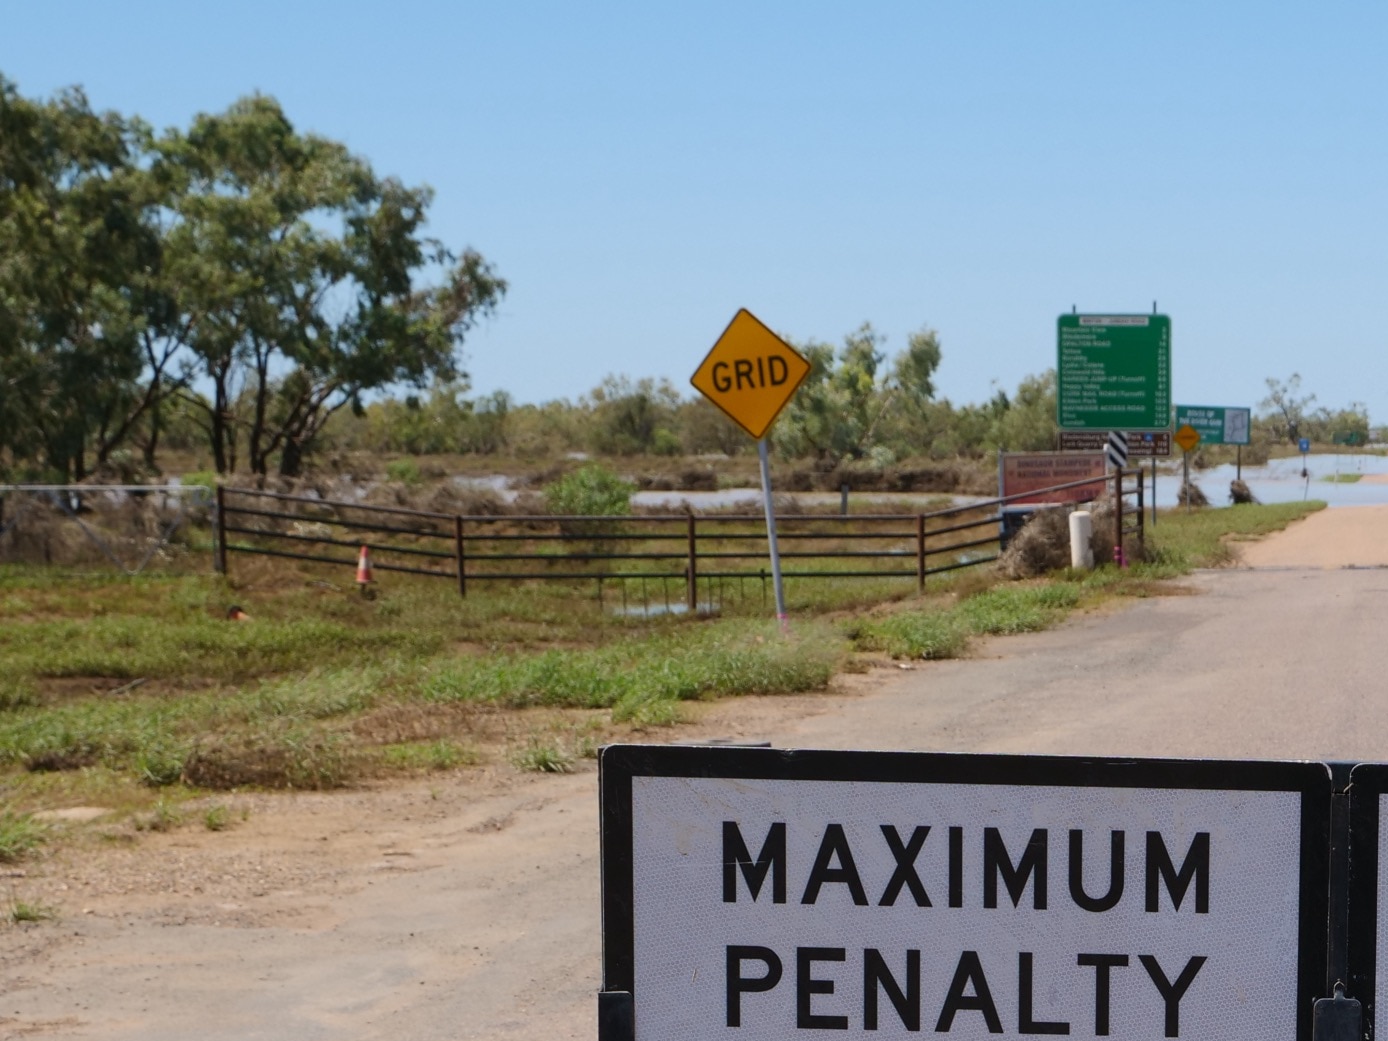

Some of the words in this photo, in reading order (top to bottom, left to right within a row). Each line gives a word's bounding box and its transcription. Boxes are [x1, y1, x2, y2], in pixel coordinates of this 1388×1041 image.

[712, 354, 789, 393] GRID
[721, 820, 1211, 914] MAXIMUM
[725, 944, 1208, 1039] PENALTY
